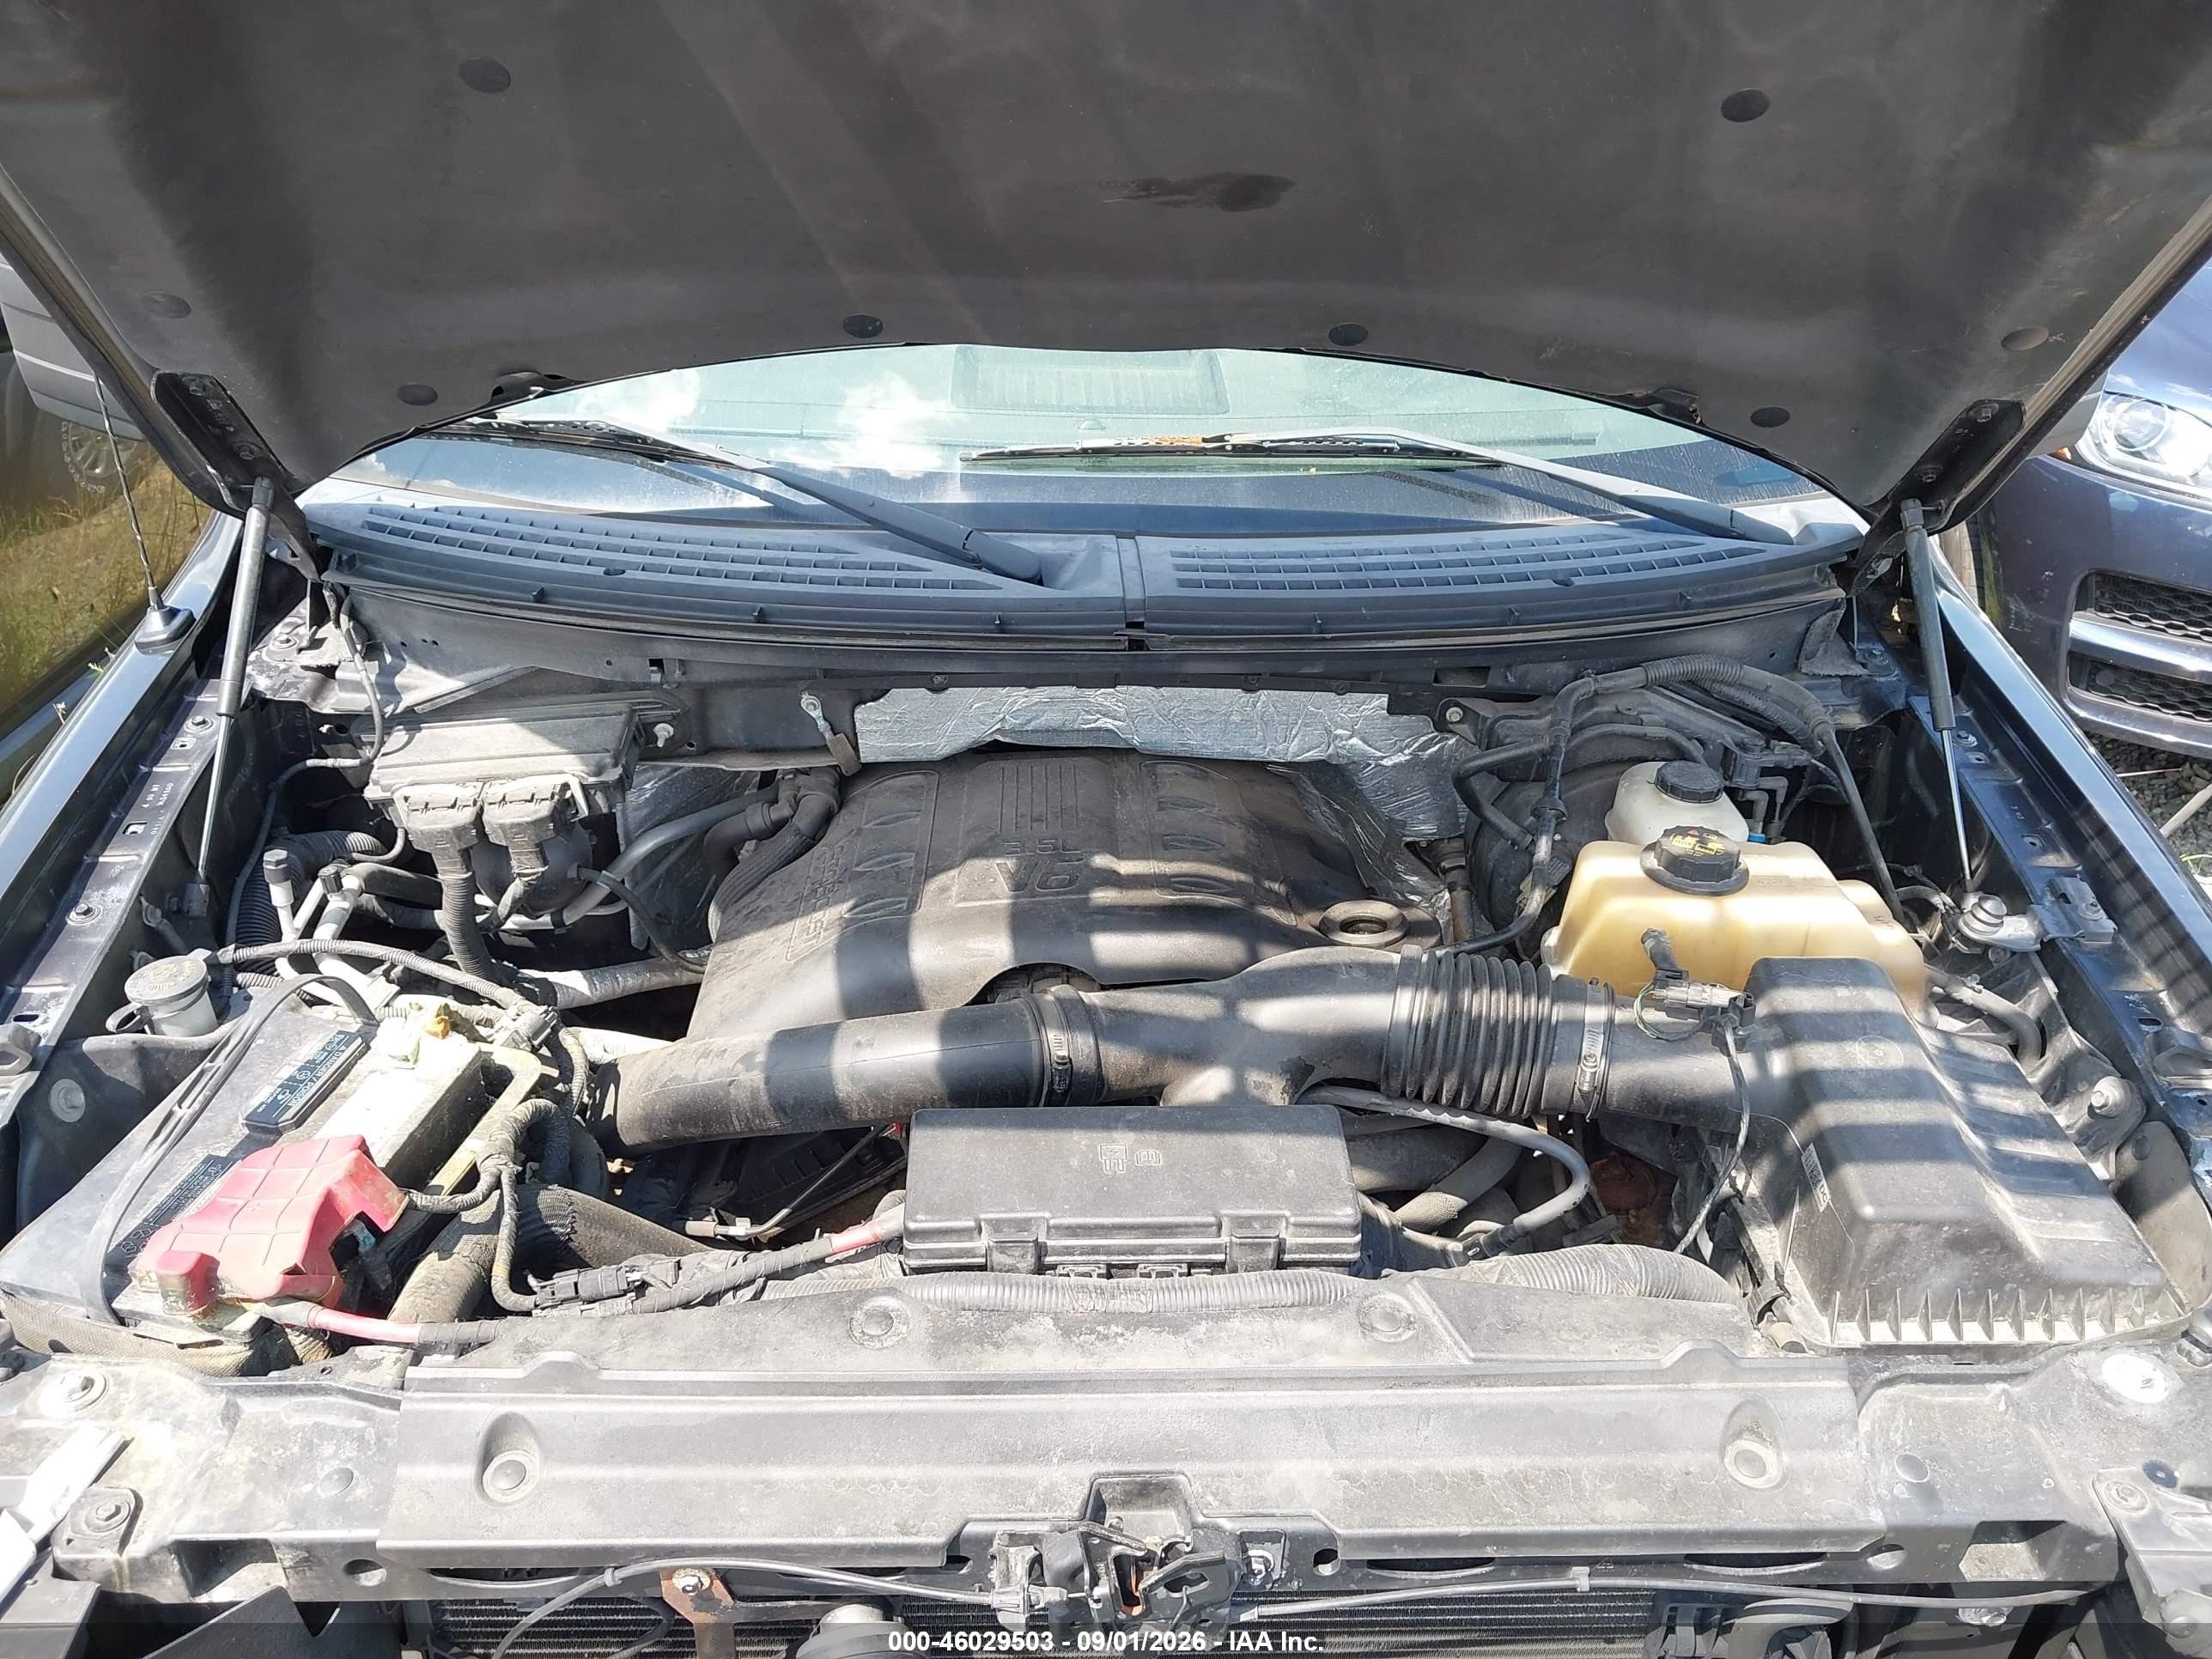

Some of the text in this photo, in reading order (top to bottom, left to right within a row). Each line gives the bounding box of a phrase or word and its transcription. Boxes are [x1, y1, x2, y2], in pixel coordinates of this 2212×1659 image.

[1003, 838, 1083, 857] 3.5L
[995, 858, 1085, 894] V6
[317, 1050, 342, 1078] DANGER
[288, 1081, 314, 1107] POISON
